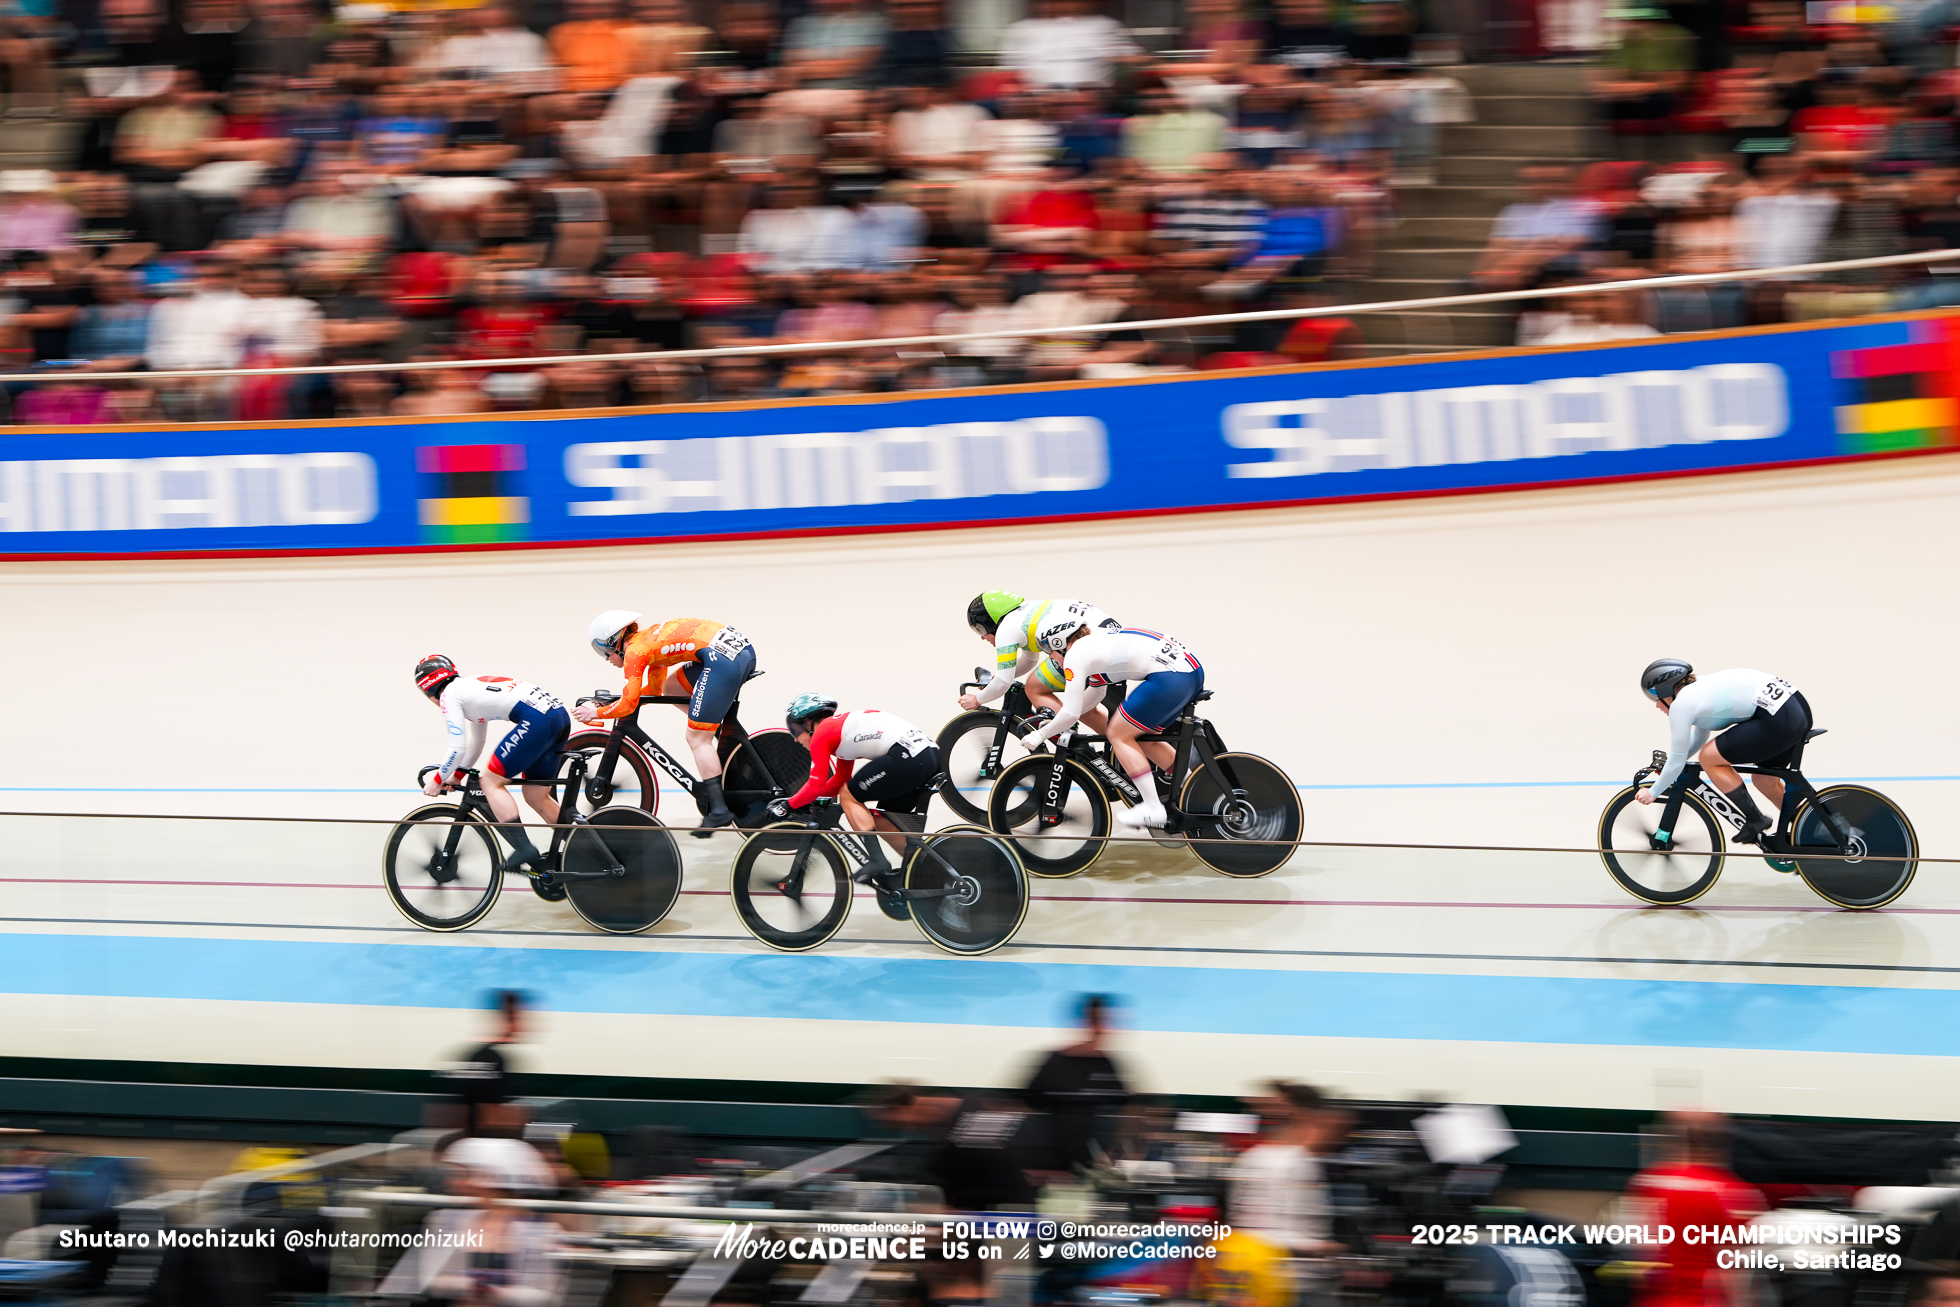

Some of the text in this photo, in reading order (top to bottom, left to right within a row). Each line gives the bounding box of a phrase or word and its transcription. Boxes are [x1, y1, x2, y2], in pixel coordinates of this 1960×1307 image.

[0, 451, 381, 533] IMANO
[718, 632, 744, 652] 122
[1040, 620, 1077, 640] LAZER
[691, 667, 712, 718] Staatsloterij
[1646, 667, 1683, 689] LAZER
[1763, 682, 1784, 701] 59
[500, 720, 531, 759] JAPAN
[853, 731, 882, 743] Canada
[642, 741, 693, 792] KOGA
[1046, 763, 1064, 808] LOTUS
[1090, 757, 1140, 798] hope
[1694, 783, 1747, 832] KOG
